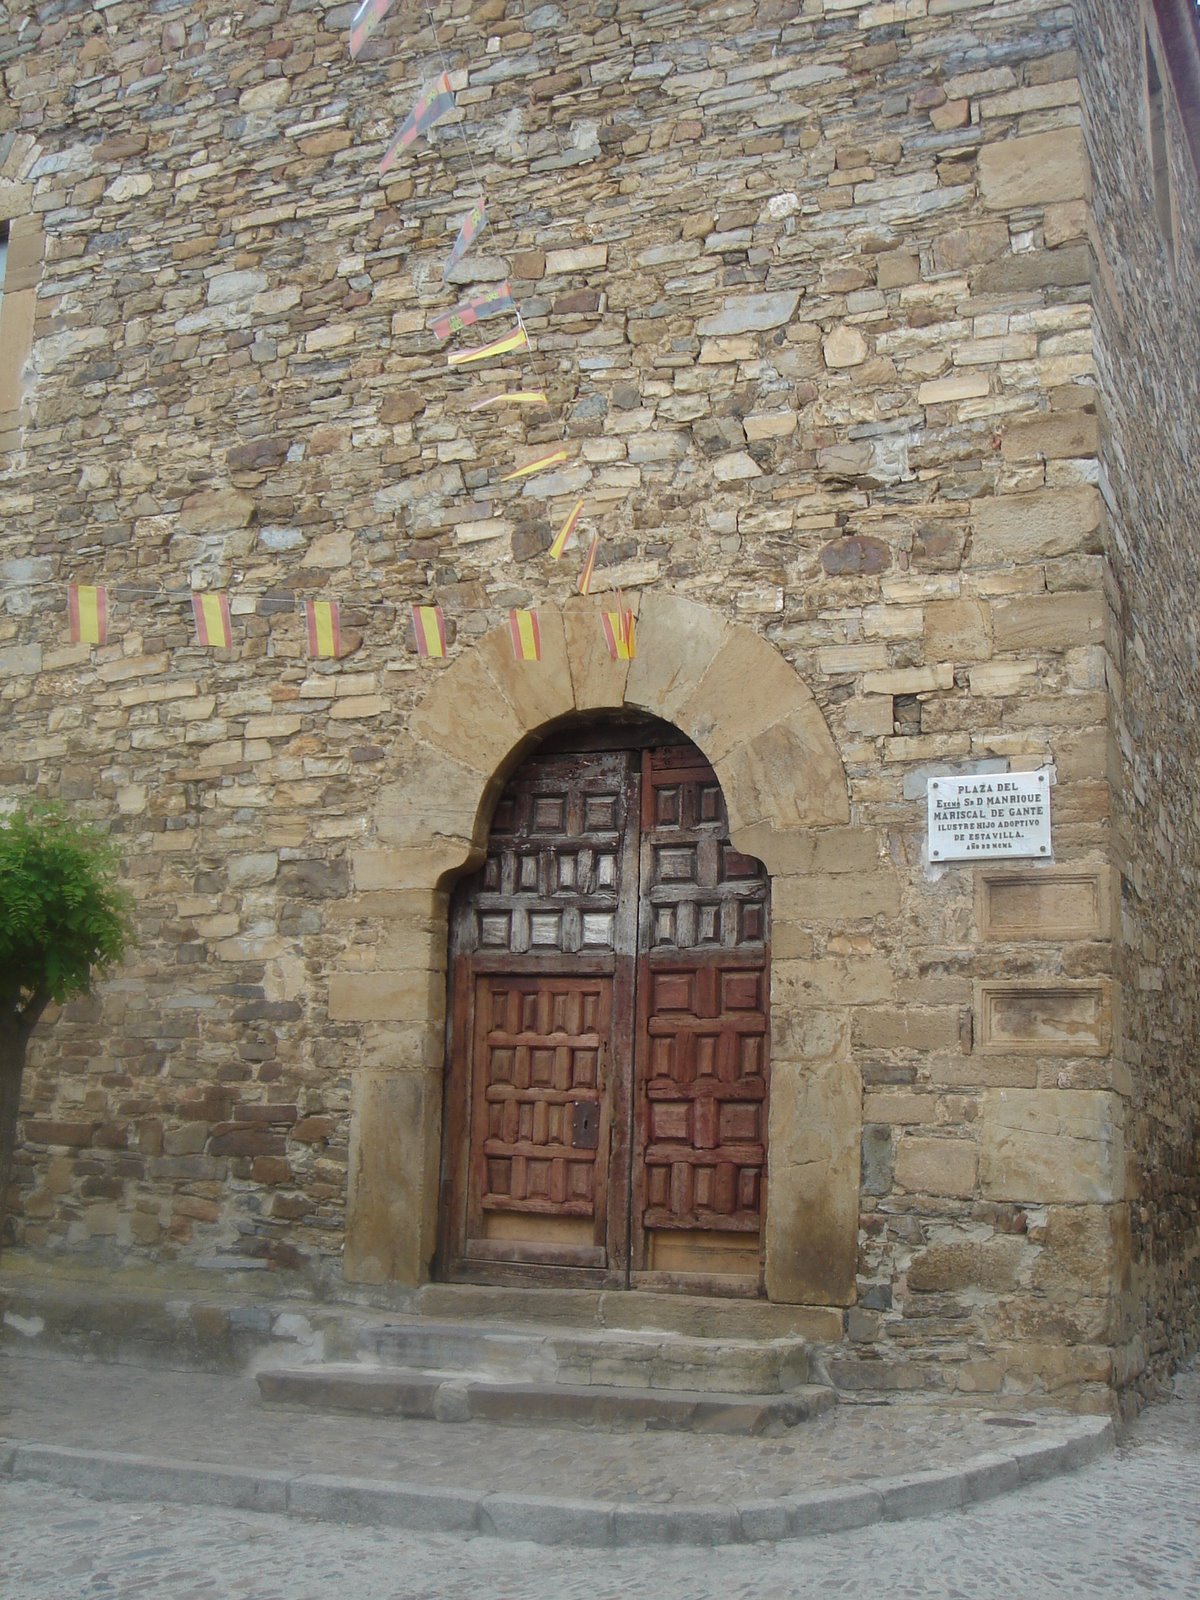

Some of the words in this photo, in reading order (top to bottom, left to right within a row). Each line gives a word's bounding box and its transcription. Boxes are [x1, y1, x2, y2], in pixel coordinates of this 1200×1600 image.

[958, 784, 993, 795] PLAZA
[997, 782, 1019, 792] DEL
[933, 810, 986, 821] MARISCAL
[991, 808, 1005, 818] DE
[1008, 806, 1044, 817] GANTE
[938, 822, 975, 831] ILUSTRE
[976, 822, 996, 830] HIJO
[997, 819, 1040, 828] ADOPTIVO
[969, 833, 991, 841] ESTA
